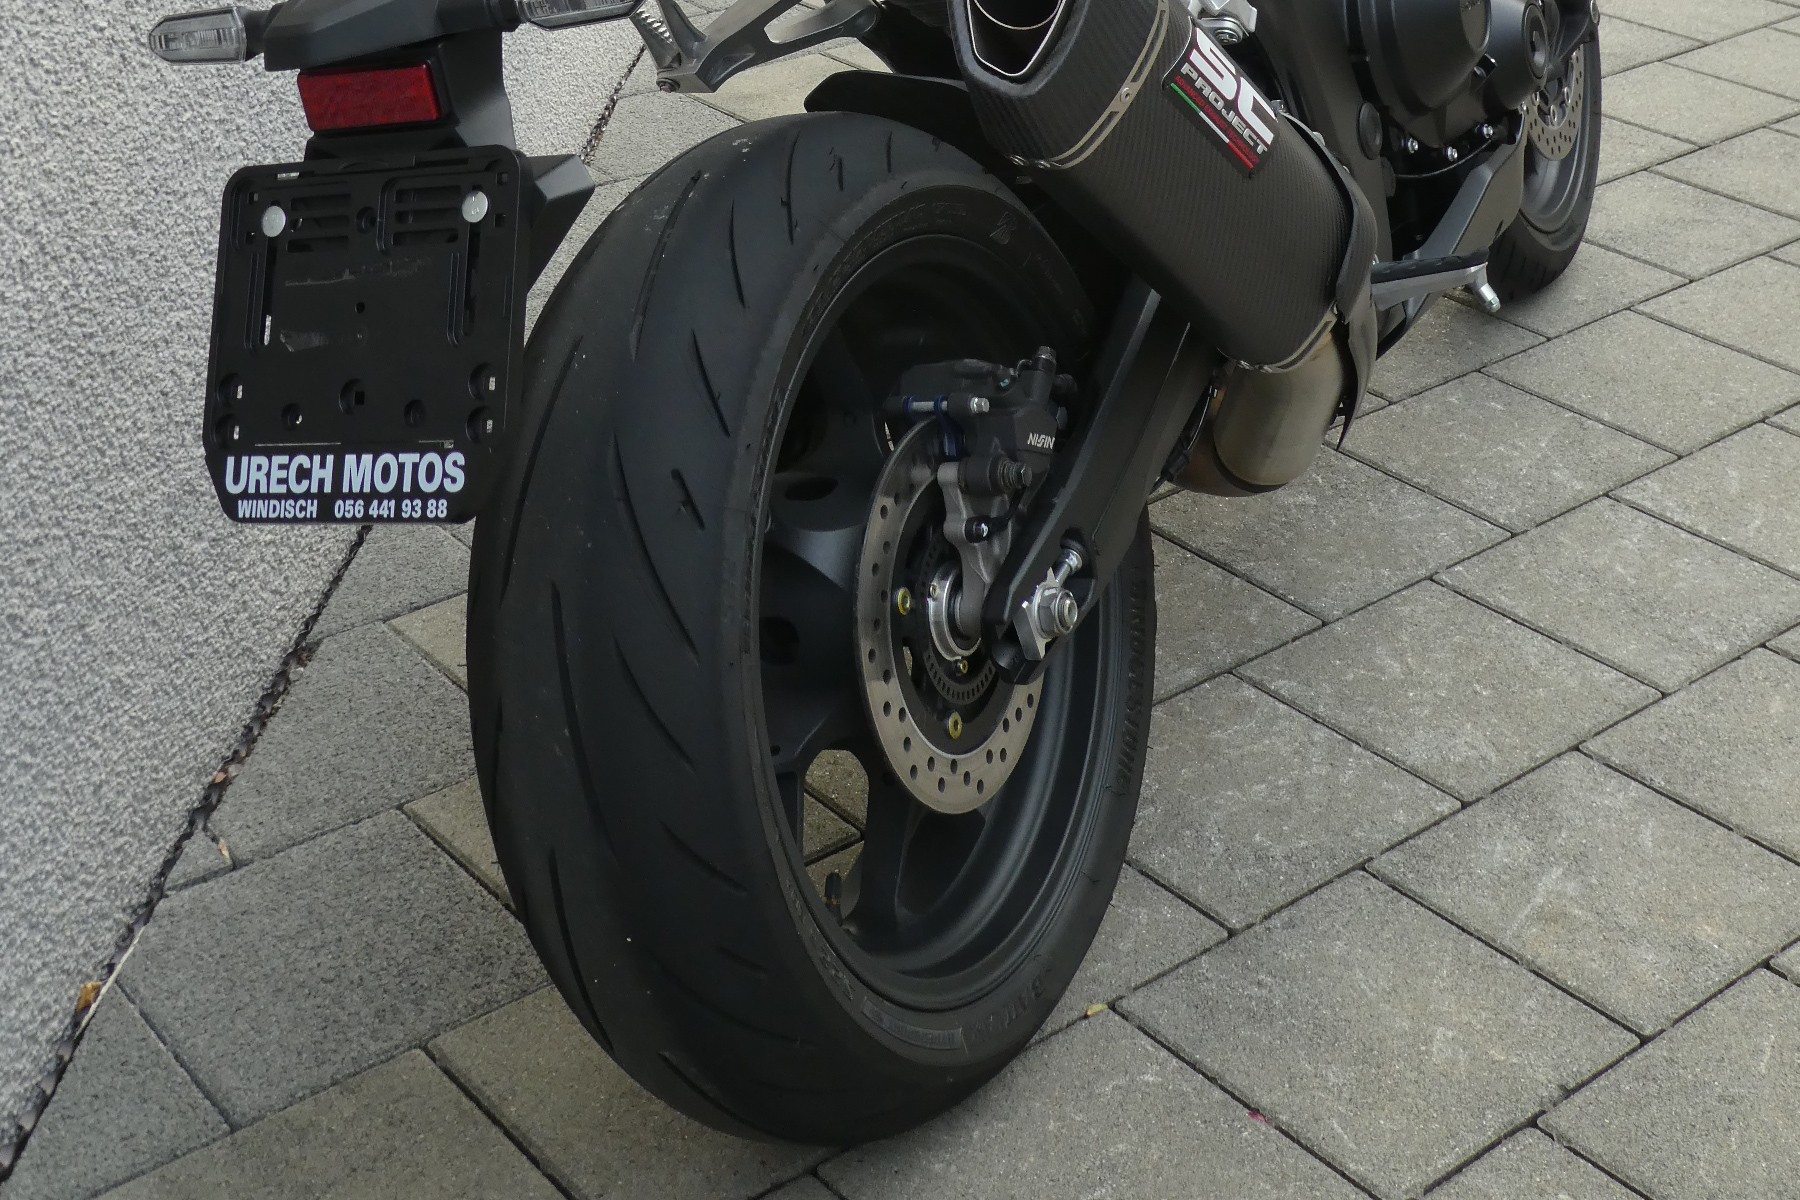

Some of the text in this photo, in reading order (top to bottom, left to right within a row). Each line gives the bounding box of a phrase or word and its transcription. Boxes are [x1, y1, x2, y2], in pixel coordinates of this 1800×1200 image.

[1180, 62, 1268, 155] PROJECT
[1188, 26, 1278, 146] SC
[225, 451, 466, 495] URECH MOTOS
[237, 497, 448, 519] WINDISCH 056 441 93 88
